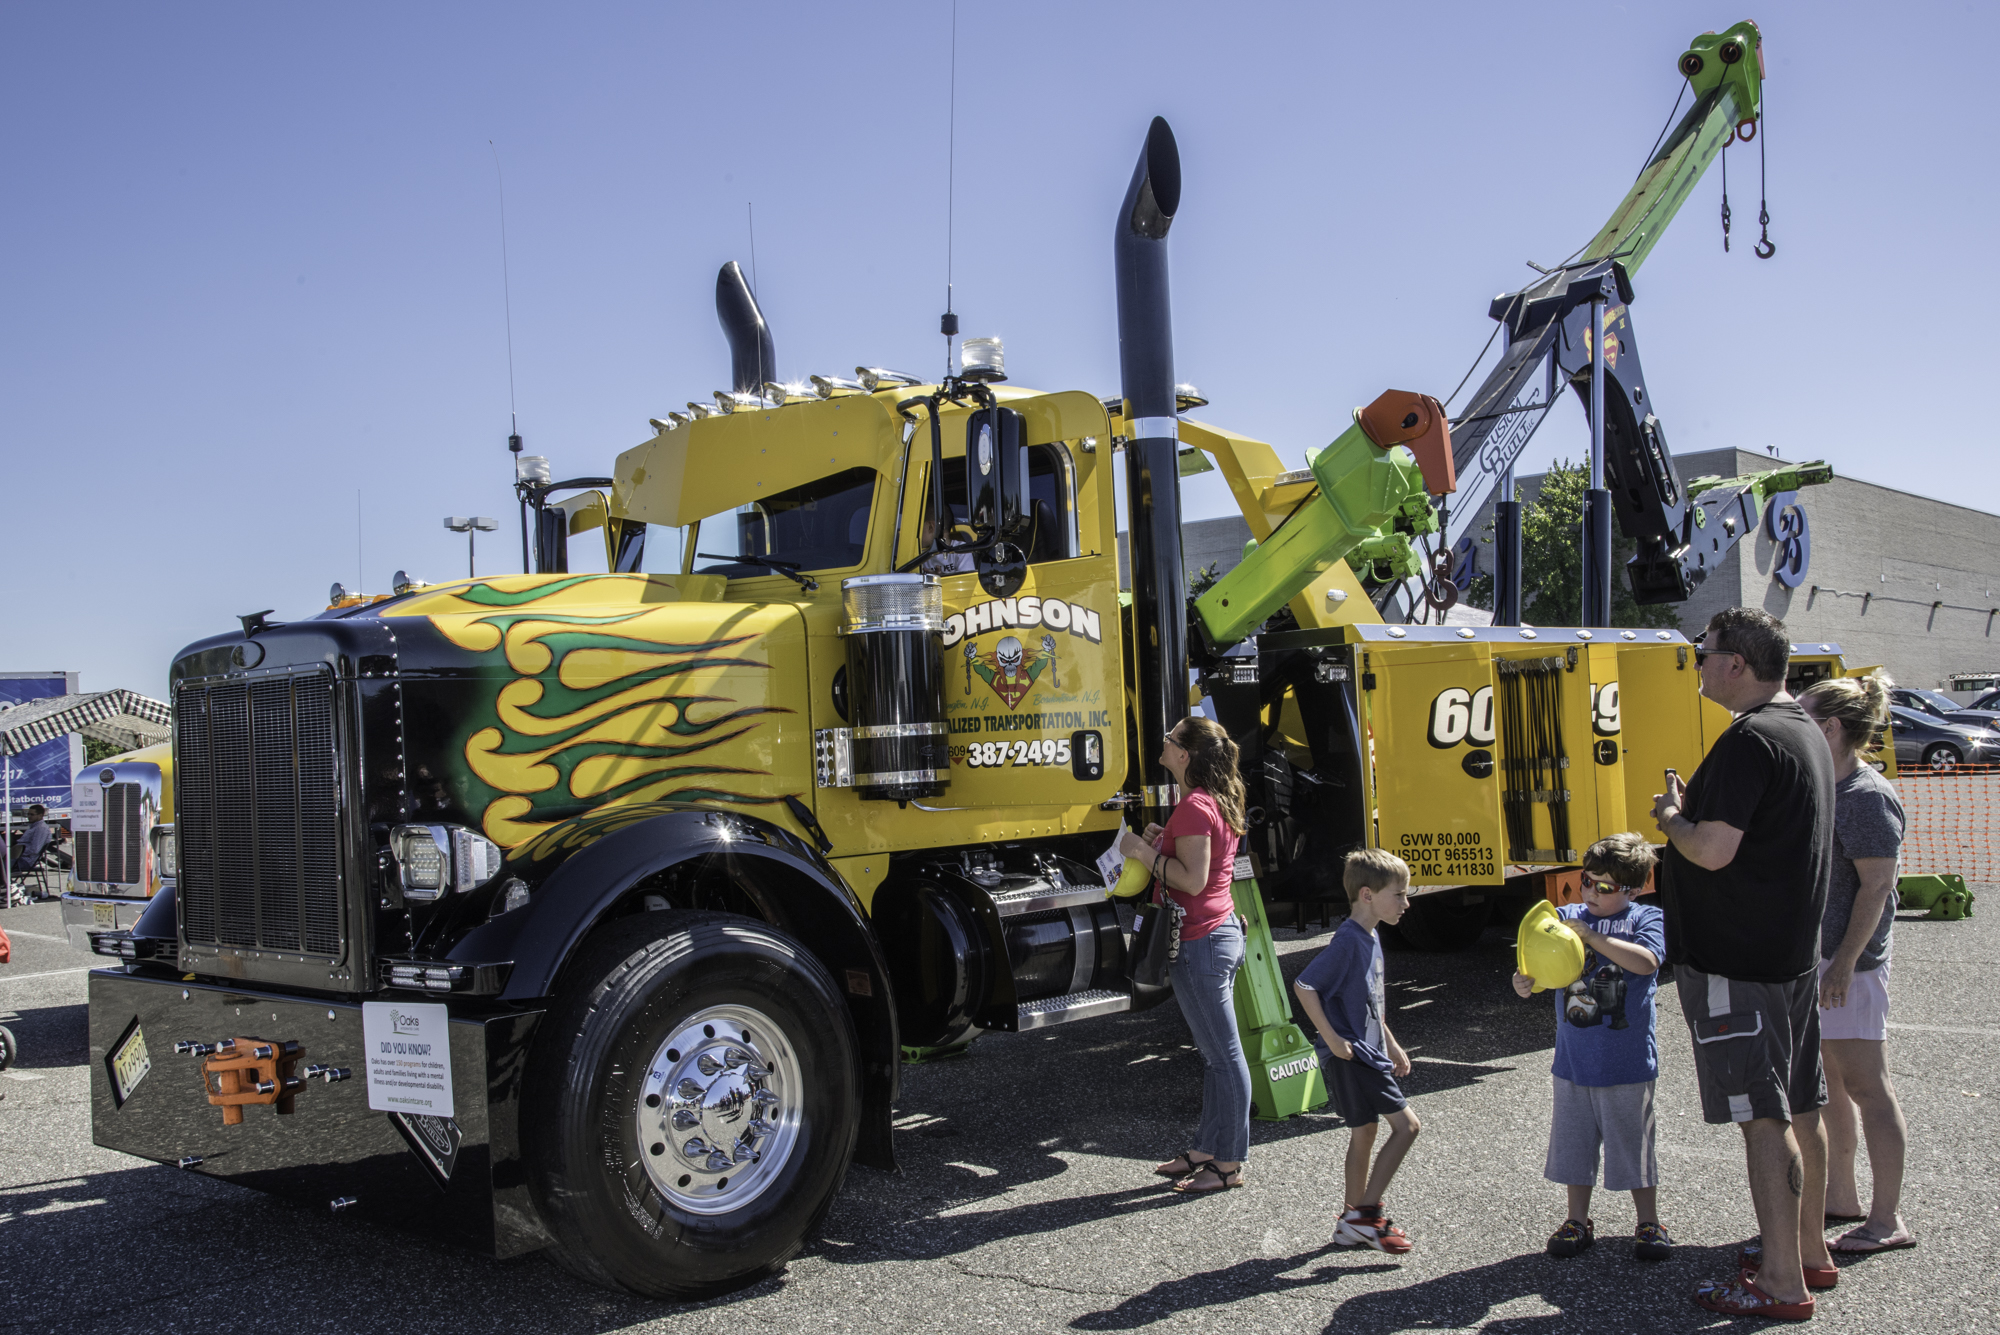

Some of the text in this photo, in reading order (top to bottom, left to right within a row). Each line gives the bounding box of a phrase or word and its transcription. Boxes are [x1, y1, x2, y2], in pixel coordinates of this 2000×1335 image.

[943, 596, 1102, 650] OHNSON
[946, 699, 968, 714] ngton,
[948, 710, 1112, 734] ALIZED TRANSPORTATION, INC.
[1400, 832, 1480, 847] GVW 80,000
[1444, 847, 1493, 861] 965513
[1421, 864, 1443, 877] MC
[1446, 862, 1494, 876] 411830
[400, 1014, 419, 1027] Oaks
[381, 1041, 431, 1056] DID YOU KNOW?
[1269, 1055, 1319, 1082] CAUTION
